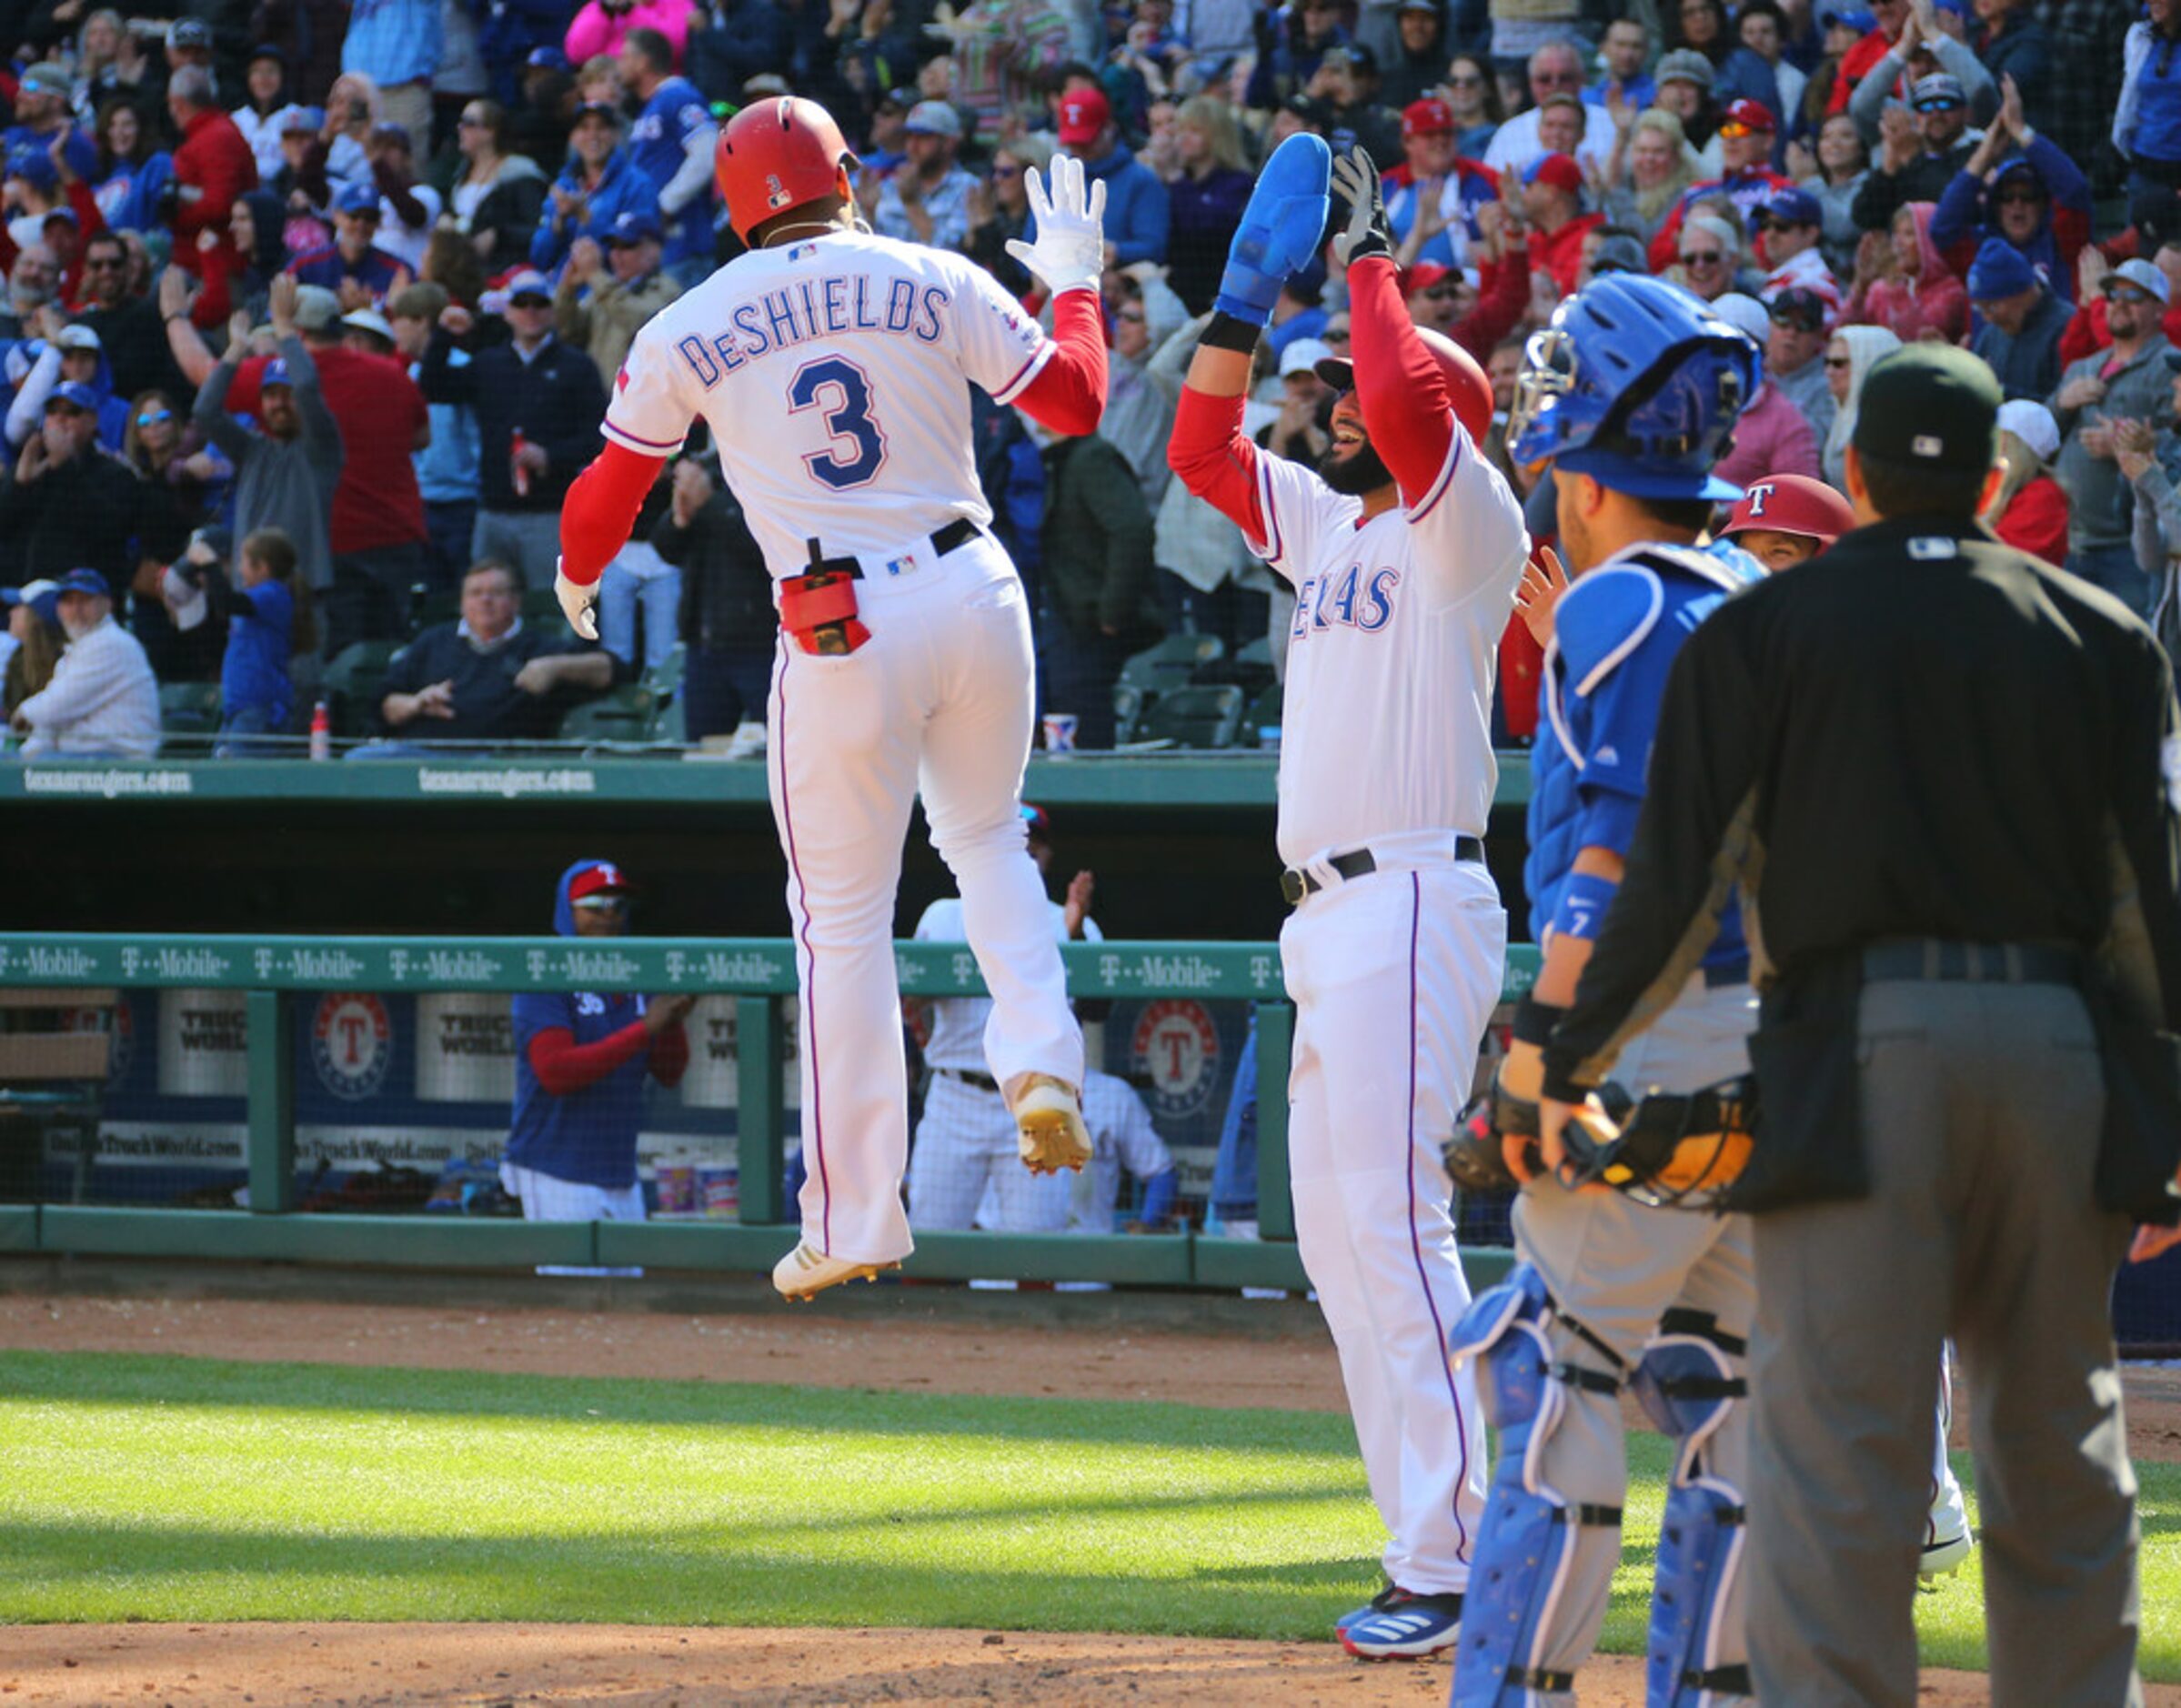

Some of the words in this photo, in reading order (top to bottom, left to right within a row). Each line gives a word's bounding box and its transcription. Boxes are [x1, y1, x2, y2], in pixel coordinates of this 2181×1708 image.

[1065, 104, 1082, 126] T
[766, 174, 782, 193] 3
[786, 353, 889, 492] 3
[1746, 484, 1775, 517] T
[1292, 562, 1402, 642] EXAS
[597, 864, 617, 886] T
[1570, 912, 1590, 937] 7
[180, 1010, 248, 1030] TRUC
[439, 1014, 513, 1034] TRUC
[181, 1031, 248, 1050] WORL
[337, 1017, 367, 1063] T
[440, 1034, 517, 1056] WORL
[1160, 1030, 1191, 1080] T
